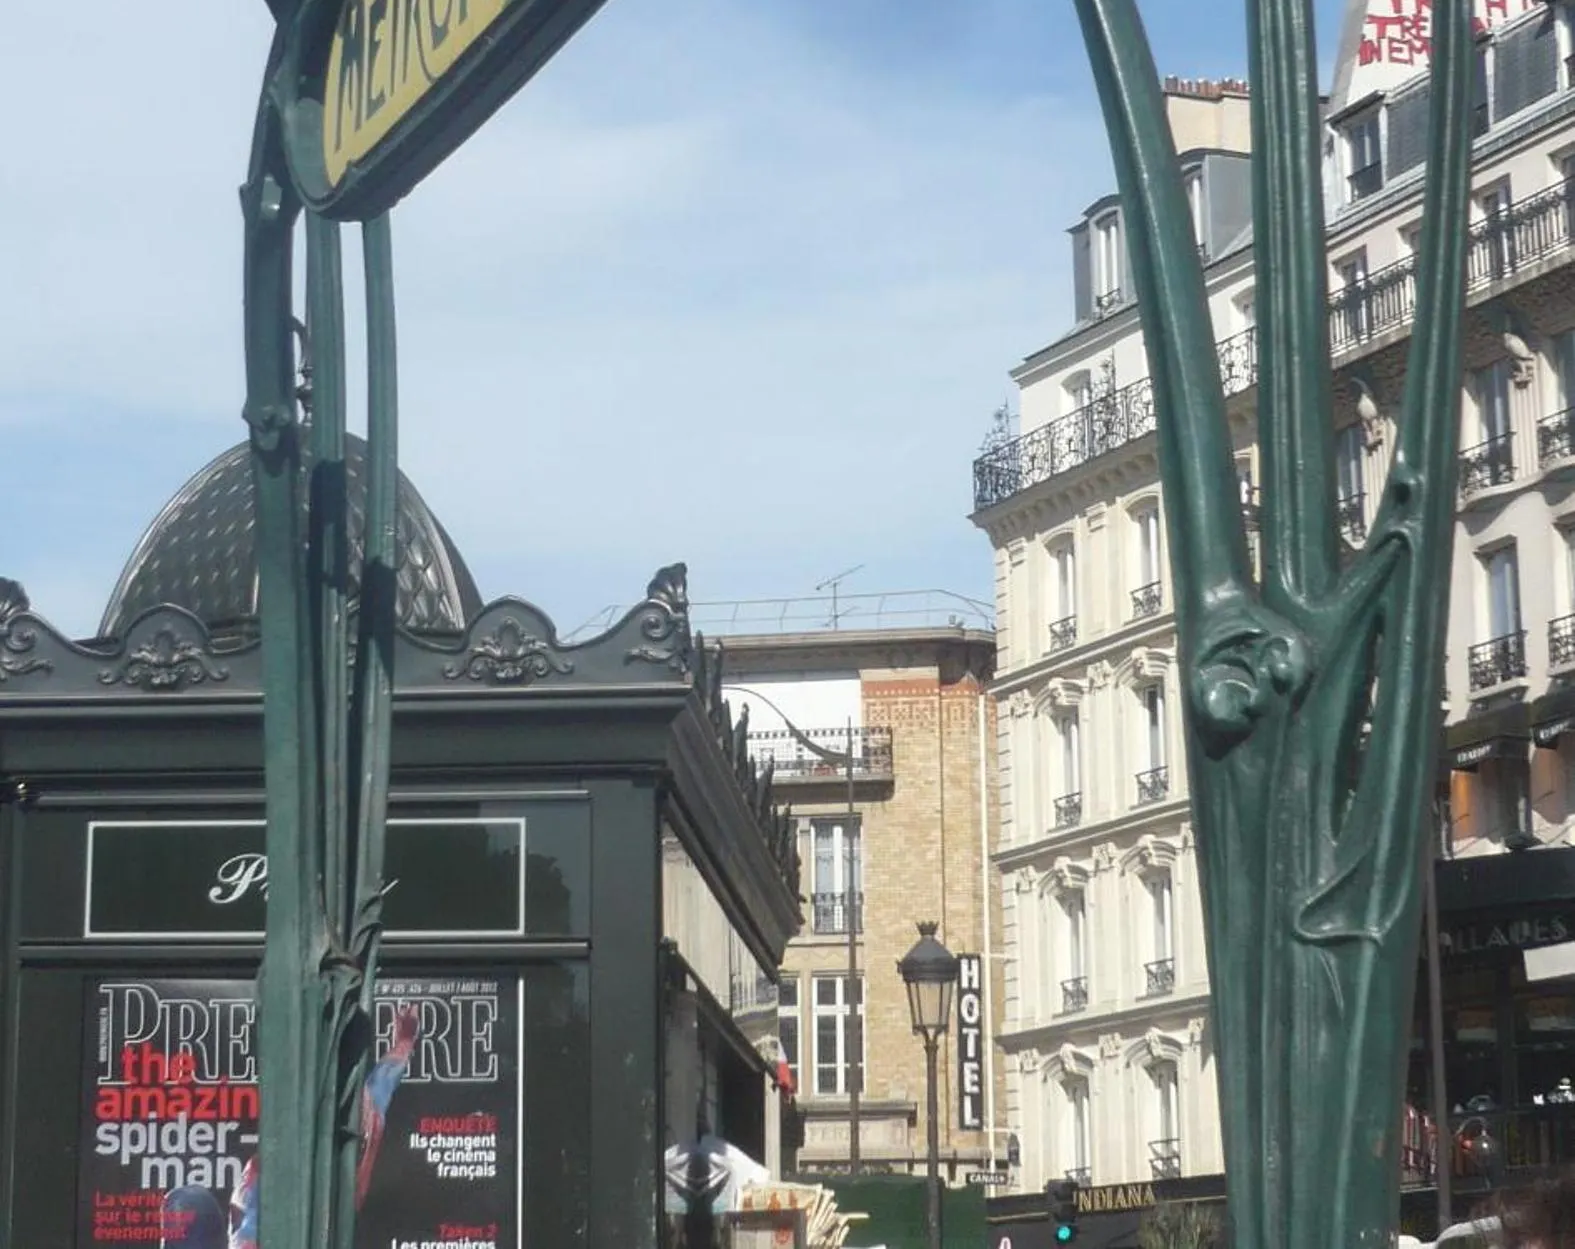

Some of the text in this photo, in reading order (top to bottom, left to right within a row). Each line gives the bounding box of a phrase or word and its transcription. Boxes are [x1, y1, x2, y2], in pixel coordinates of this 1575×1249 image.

[960, 958, 981, 1127] HOTEL
[121, 1042, 197, 1085] the
[96, 1075, 260, 1119] amazin
[95, 1111, 260, 1165] spider-
[410, 1134, 496, 1150] Ils changent
[428, 1149, 441, 1162] le
[438, 1163, 496, 1181] français
[141, 1156, 242, 1189] man
[1072, 1183, 1156, 1212] INDIANA
